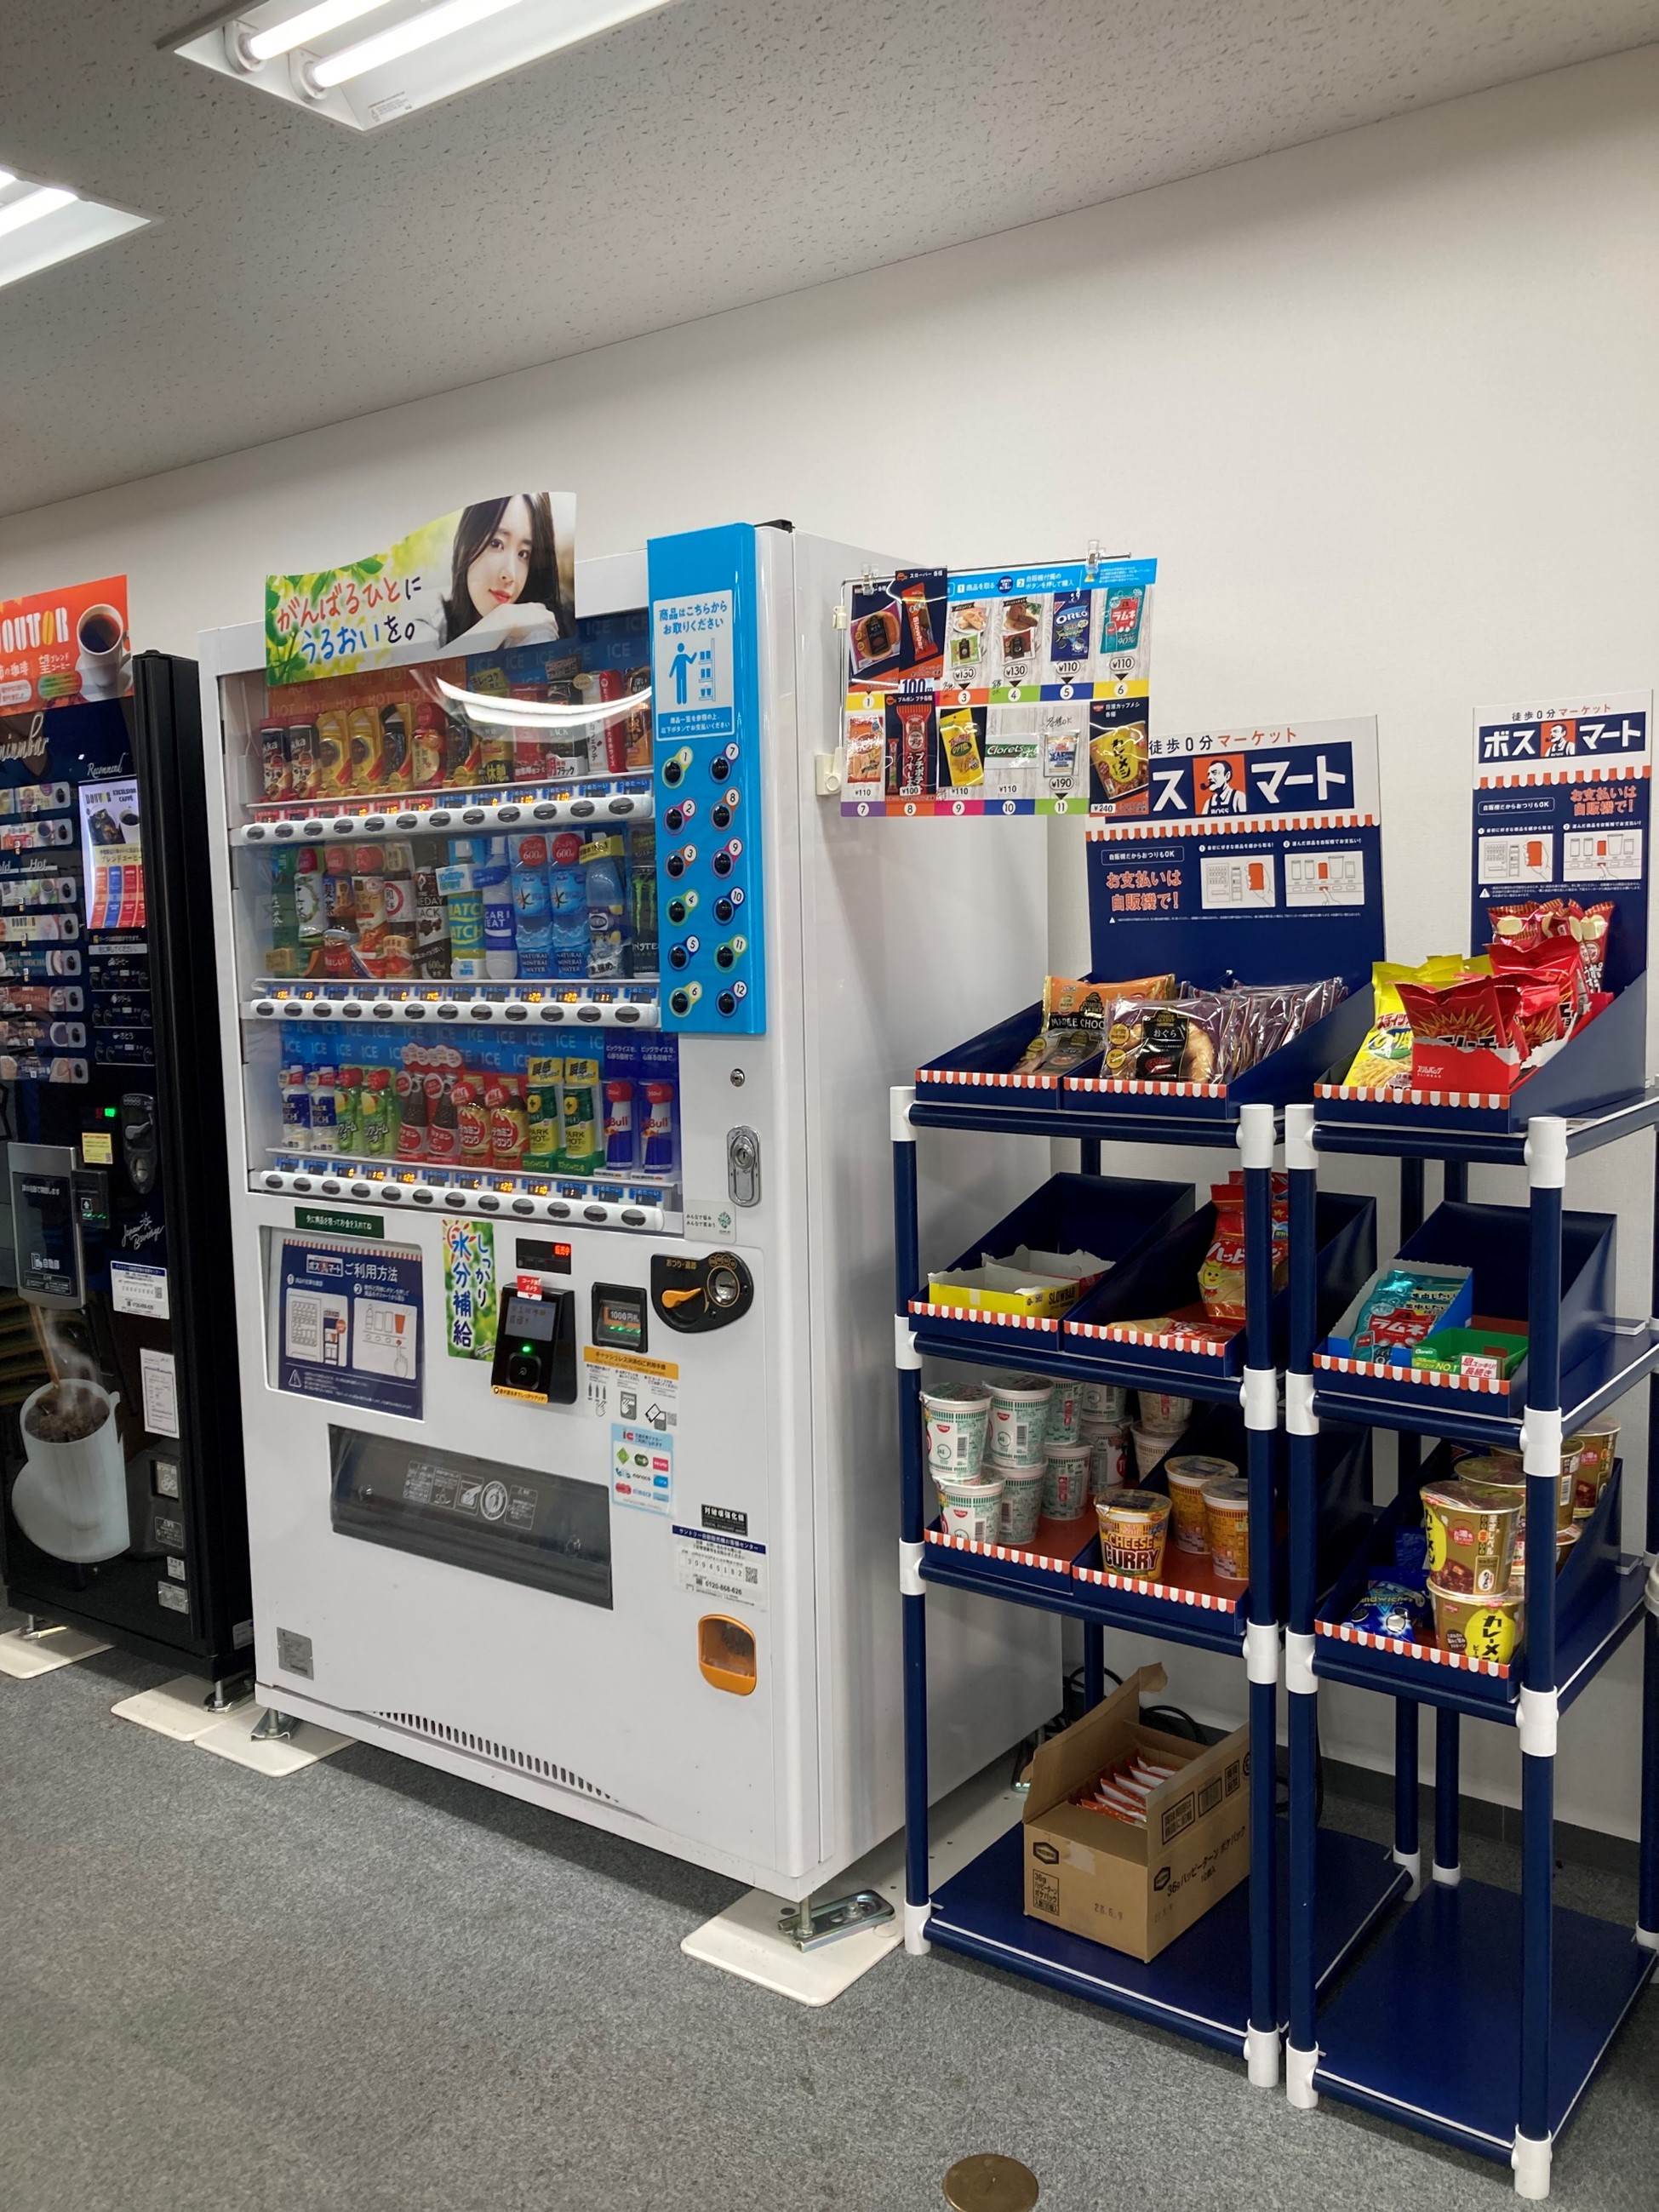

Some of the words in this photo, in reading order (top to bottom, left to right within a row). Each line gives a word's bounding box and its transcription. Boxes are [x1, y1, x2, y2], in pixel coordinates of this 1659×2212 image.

[966, 582, 994, 592] 商品を取る
[277, 576, 422, 632] がんばるひとに
[659, 600, 728, 621] 商品はこちらから
[1112, 610, 1136, 621] ラムネ
[1055, 610, 1088, 625] OREO
[0, 607, 69, 654] OUTOR
[663, 617, 724, 635] お取りください
[301, 614, 415, 664] うるおいを。
[1058, 663, 1078, 672] ¥110
[1113, 659, 1132, 669] ¥110
[1006, 666, 1026, 676] ¥130
[1063, 688, 1070, 697] 5
[1118, 684, 1124, 694] 6
[961, 692, 968, 702] 3
[1010, 689, 1017, 700] 4
[1484, 729, 1536, 758] ボス
[1579, 719, 1641, 750] マート
[684, 752, 689, 761] 1
[729, 747, 735, 756] 7
[1051, 779, 1073, 789] ¥190
[1251, 754, 1347, 804] マート
[951, 786, 969, 796] ¥110
[999, 785, 1017, 793] ¥110
[1570, 785, 1637, 802] お支払いは
[729, 792, 735, 802] 8
[686, 804, 692, 813] 2
[860, 804, 867, 814] 7
[907, 803, 913, 814] 8
[955, 803, 962, 813] 9
[1003, 803, 1014, 813] 10
[1057, 803, 1065, 813] 11
[1094, 804, 1113, 813] ¥240
[732, 843, 738, 852] 9
[687, 850, 693, 859] 3
[1108, 850, 1176, 861] 自販機だからおつりもOK
[1106, 869, 1182, 889] お支払いは
[688, 895, 694, 905] 4
[734, 892, 742, 901] 10
[1111, 891, 1180, 912] 自販機で!
[689, 940, 695, 949] 5
[736, 940, 743, 950] 11
[692, 987, 697, 996] 6
[736, 985, 744, 994] 12
[1153, 1028, 1178, 1038] おぐら
[345, 1262, 398, 1283] ご利用方法
[476, 1232, 492, 1308] しっかり
[452, 1231, 472, 1348] 水分補給
[1372, 1318, 1425, 1336] ラムネ
[1435, 1363, 1459, 1372] NO.1
[1464, 1366, 1493, 1377] 長続き
[1109, 1533, 1154, 1550] CHEESE
[1104, 1540, 1160, 1570] CURRY
